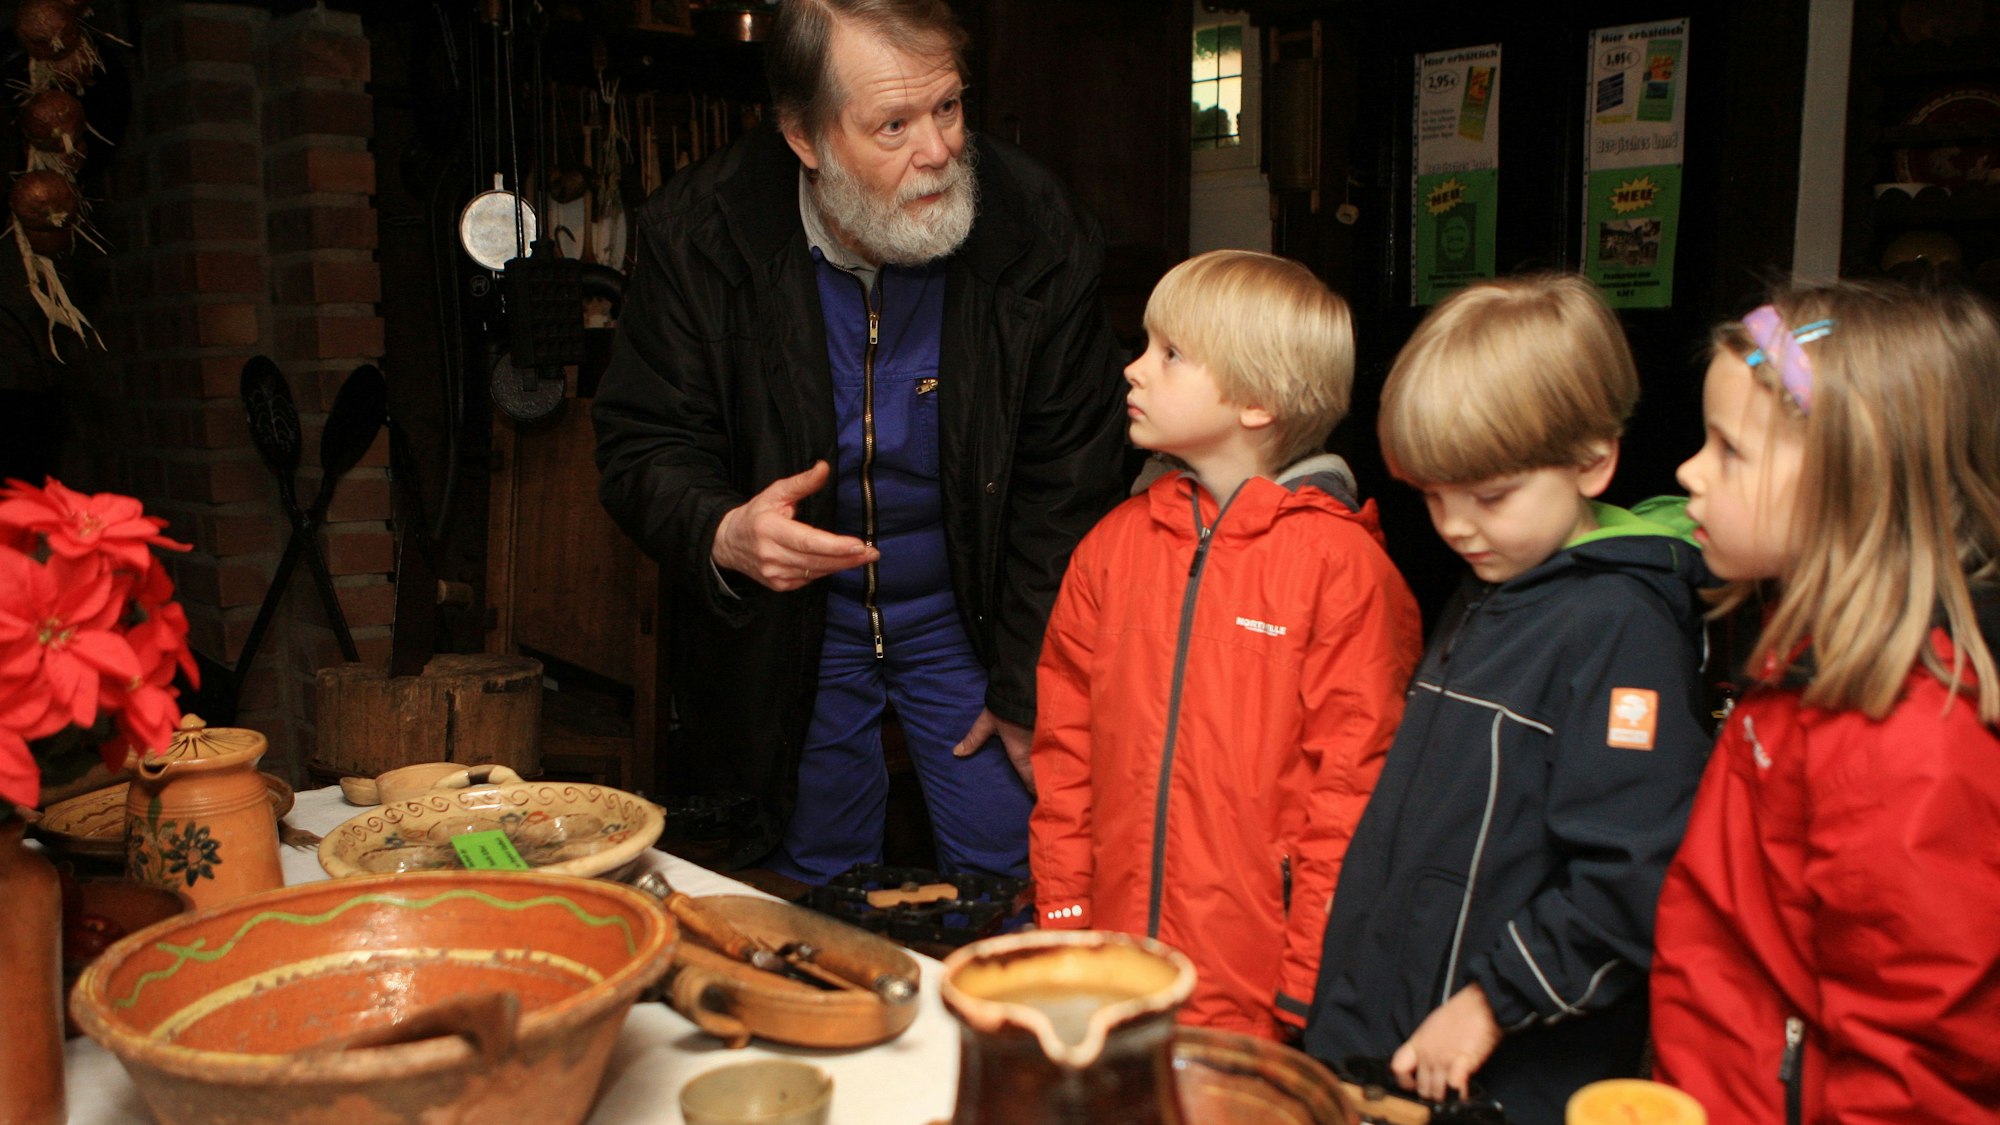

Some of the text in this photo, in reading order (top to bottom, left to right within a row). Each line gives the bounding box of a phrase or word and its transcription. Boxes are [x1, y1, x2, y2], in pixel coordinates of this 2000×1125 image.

[1601, 25, 1684, 43] Hier erhältlich
[1424, 49, 1498, 66] Hier erhältlich
[1652, 131, 1679, 150] Land
[1431, 187, 1459, 207] NEU
[1617, 188, 1653, 203] NEU
